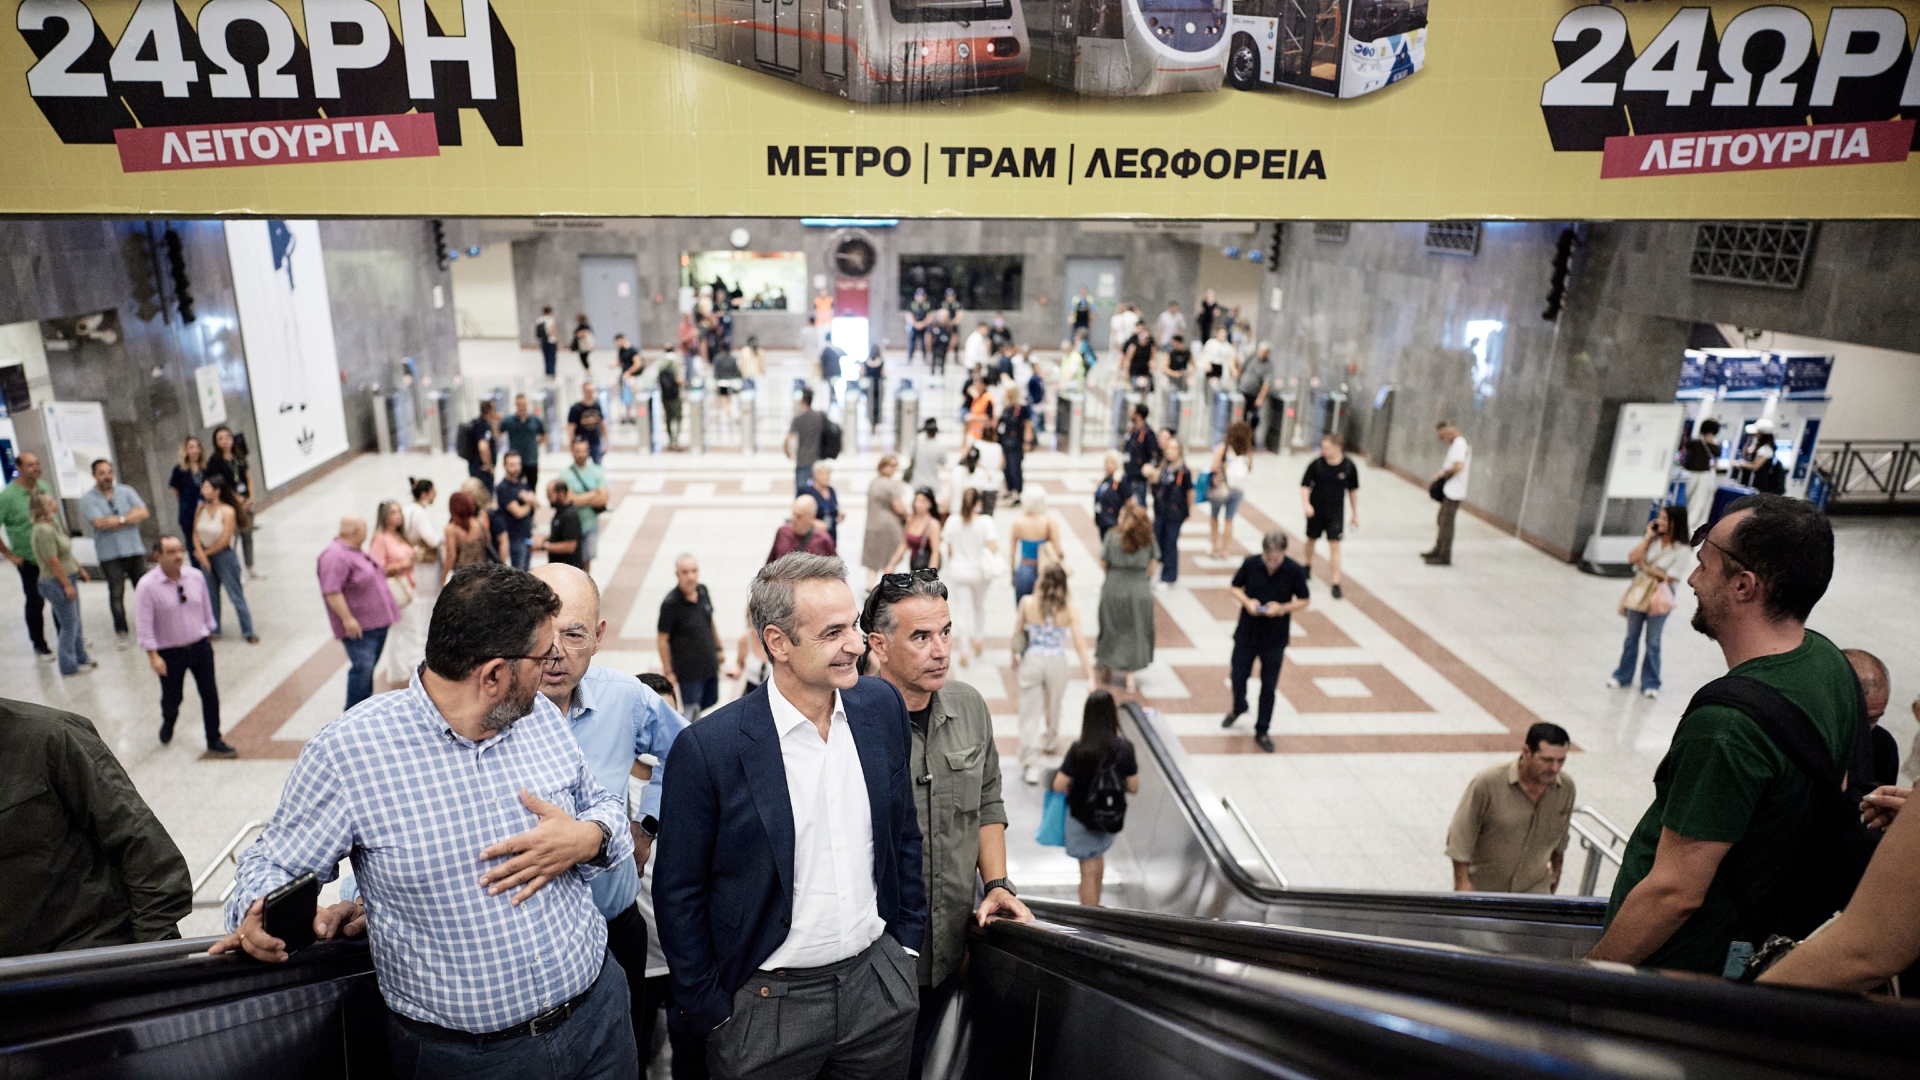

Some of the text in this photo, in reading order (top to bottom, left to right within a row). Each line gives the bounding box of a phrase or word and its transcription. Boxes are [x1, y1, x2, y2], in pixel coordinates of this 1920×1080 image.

[17, 0, 497, 99] 24ΩΡΗ
[1541, 6, 1920, 107] 24ΩΡ
[161, 120, 400, 165] ΛΕΙΤΟΥΡΓΙΑ
[766, 145, 1328, 180] ΜΕΤΡΟ ΤΡΑΜ ΛΕΩΦΟΡΕΙΑ
[1639, 127, 1871, 171] ΛΕΙΤΟΥΡΓΙΑ
